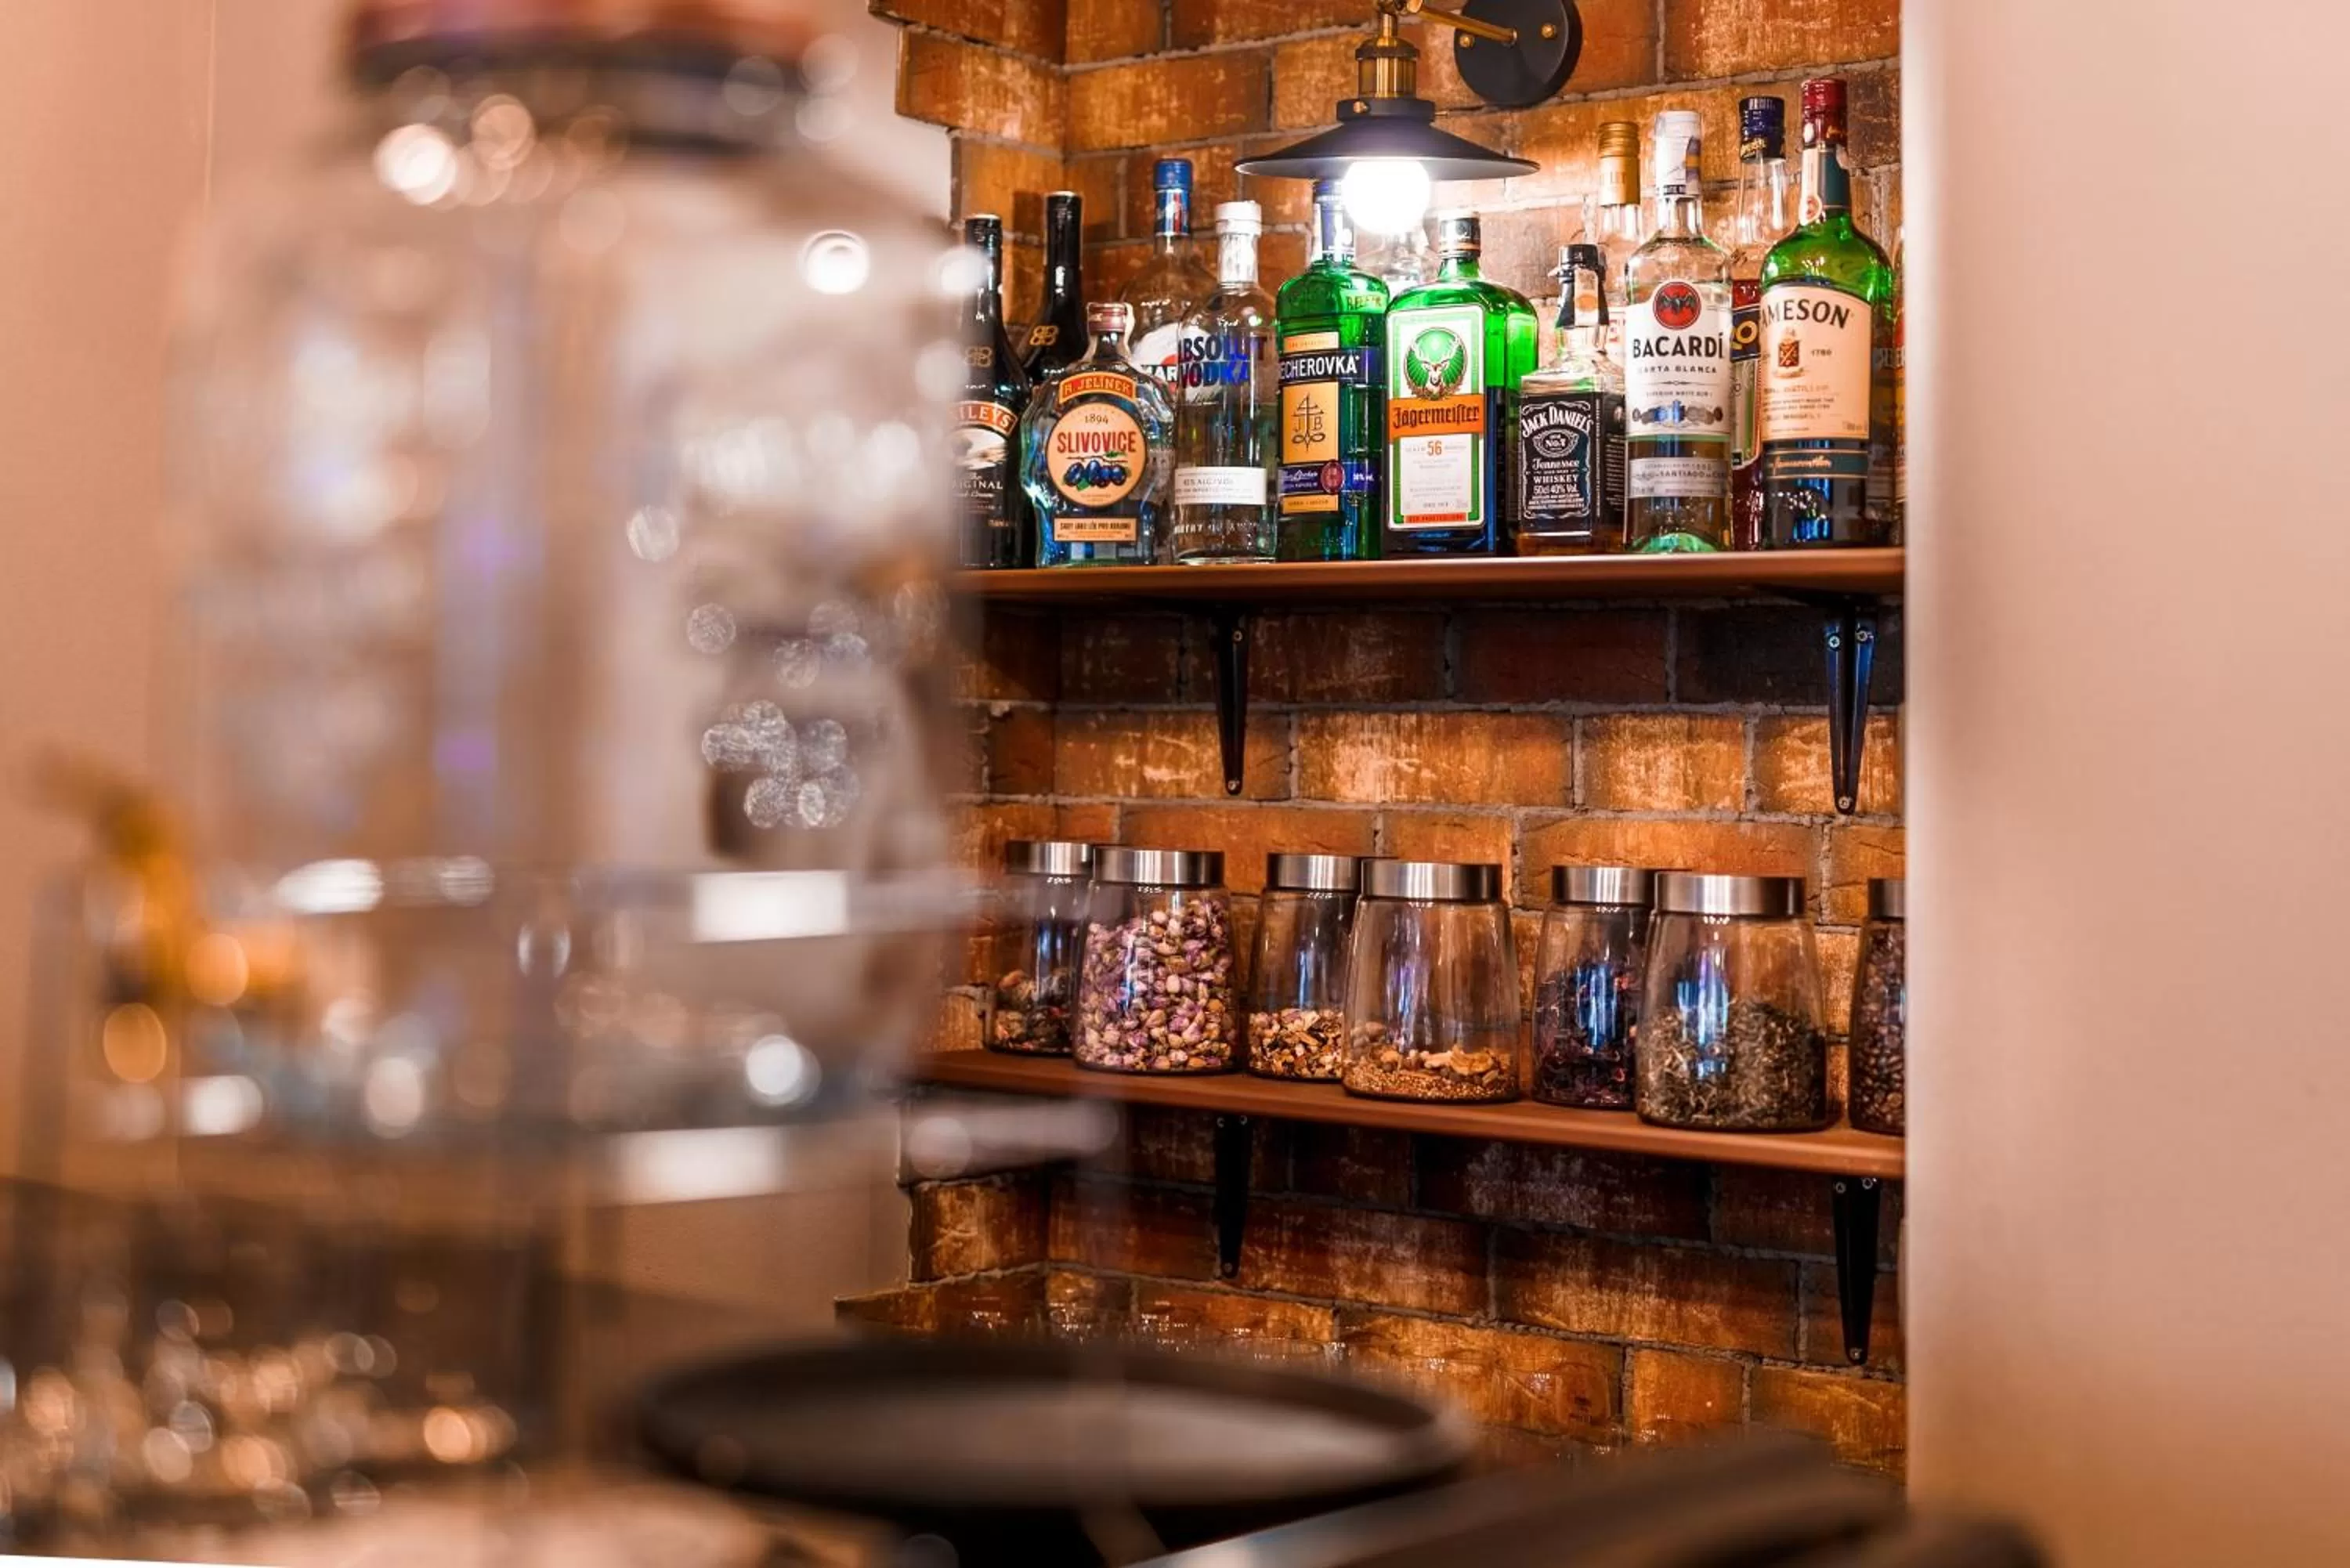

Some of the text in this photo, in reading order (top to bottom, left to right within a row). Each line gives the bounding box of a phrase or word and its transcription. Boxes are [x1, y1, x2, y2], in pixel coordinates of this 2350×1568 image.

[1762, 298, 1850, 330] AMESON
[1632, 332, 1723, 359] BACARDÍ
[1180, 360, 1250, 388] VODKA
[1280, 355, 1358, 379] ECHEROVKA
[955, 406, 1012, 428] ILEYS
[1085, 414, 1108, 425] 1894
[1522, 410, 1549, 438] JACK
[1057, 431, 1137, 453] SLIVOVICE
[1426, 439, 1443, 457] 56
[1533, 474, 1579, 484] WHISKEY
